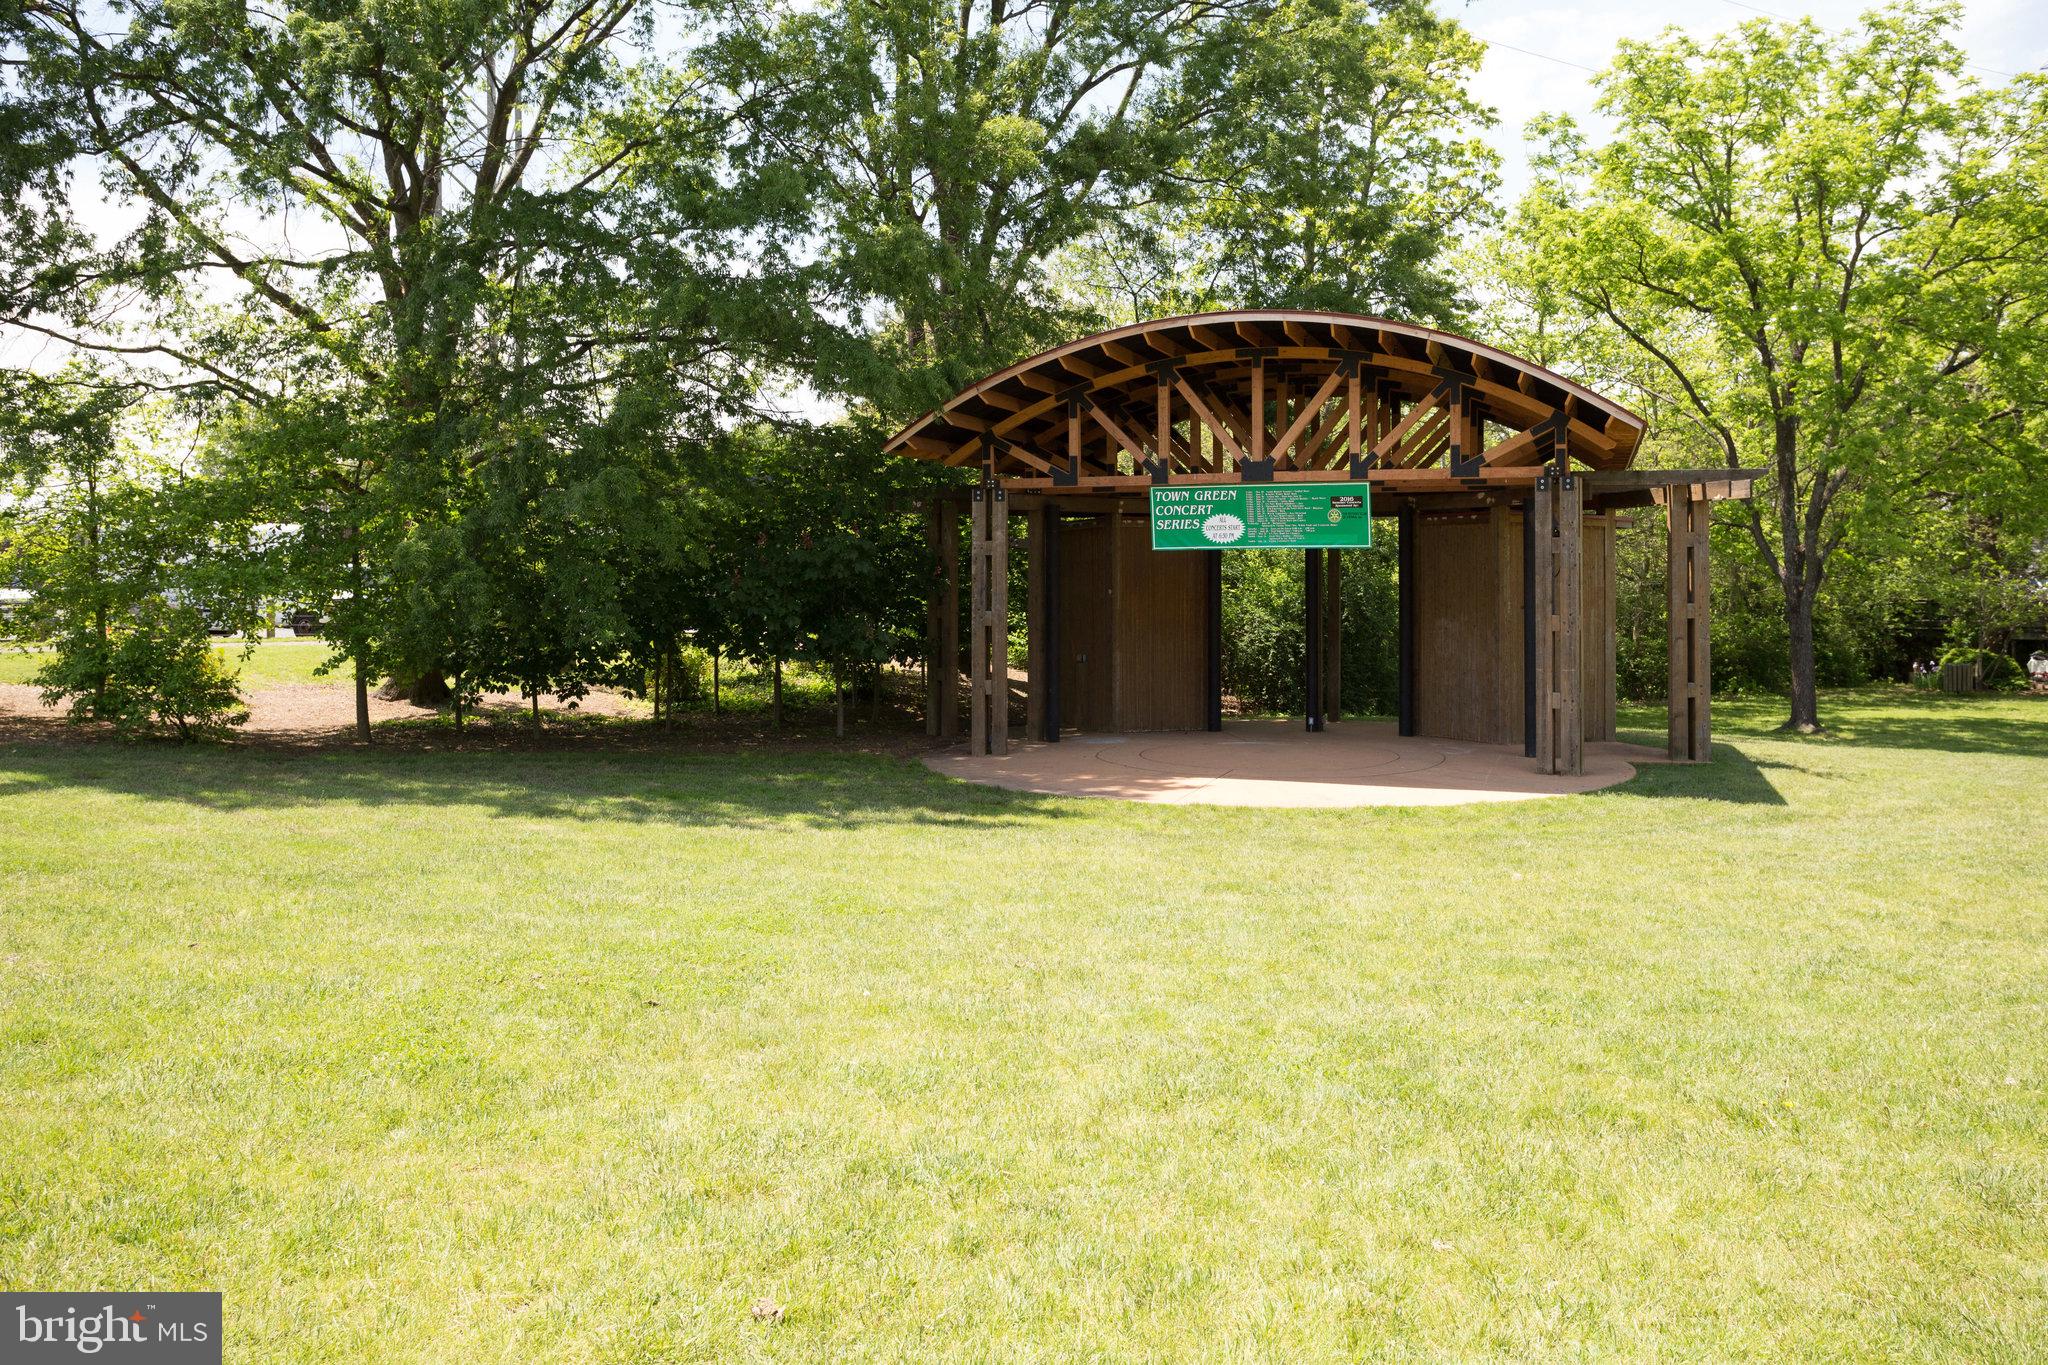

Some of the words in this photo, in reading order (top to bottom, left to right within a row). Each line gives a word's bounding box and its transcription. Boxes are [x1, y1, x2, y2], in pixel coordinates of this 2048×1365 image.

[1155, 491, 1190, 502] TOWN
[1194, 490, 1237, 501] GREEN
[1155, 505, 1214, 516] CONCERT
[1156, 519, 1200, 530] SERIES
